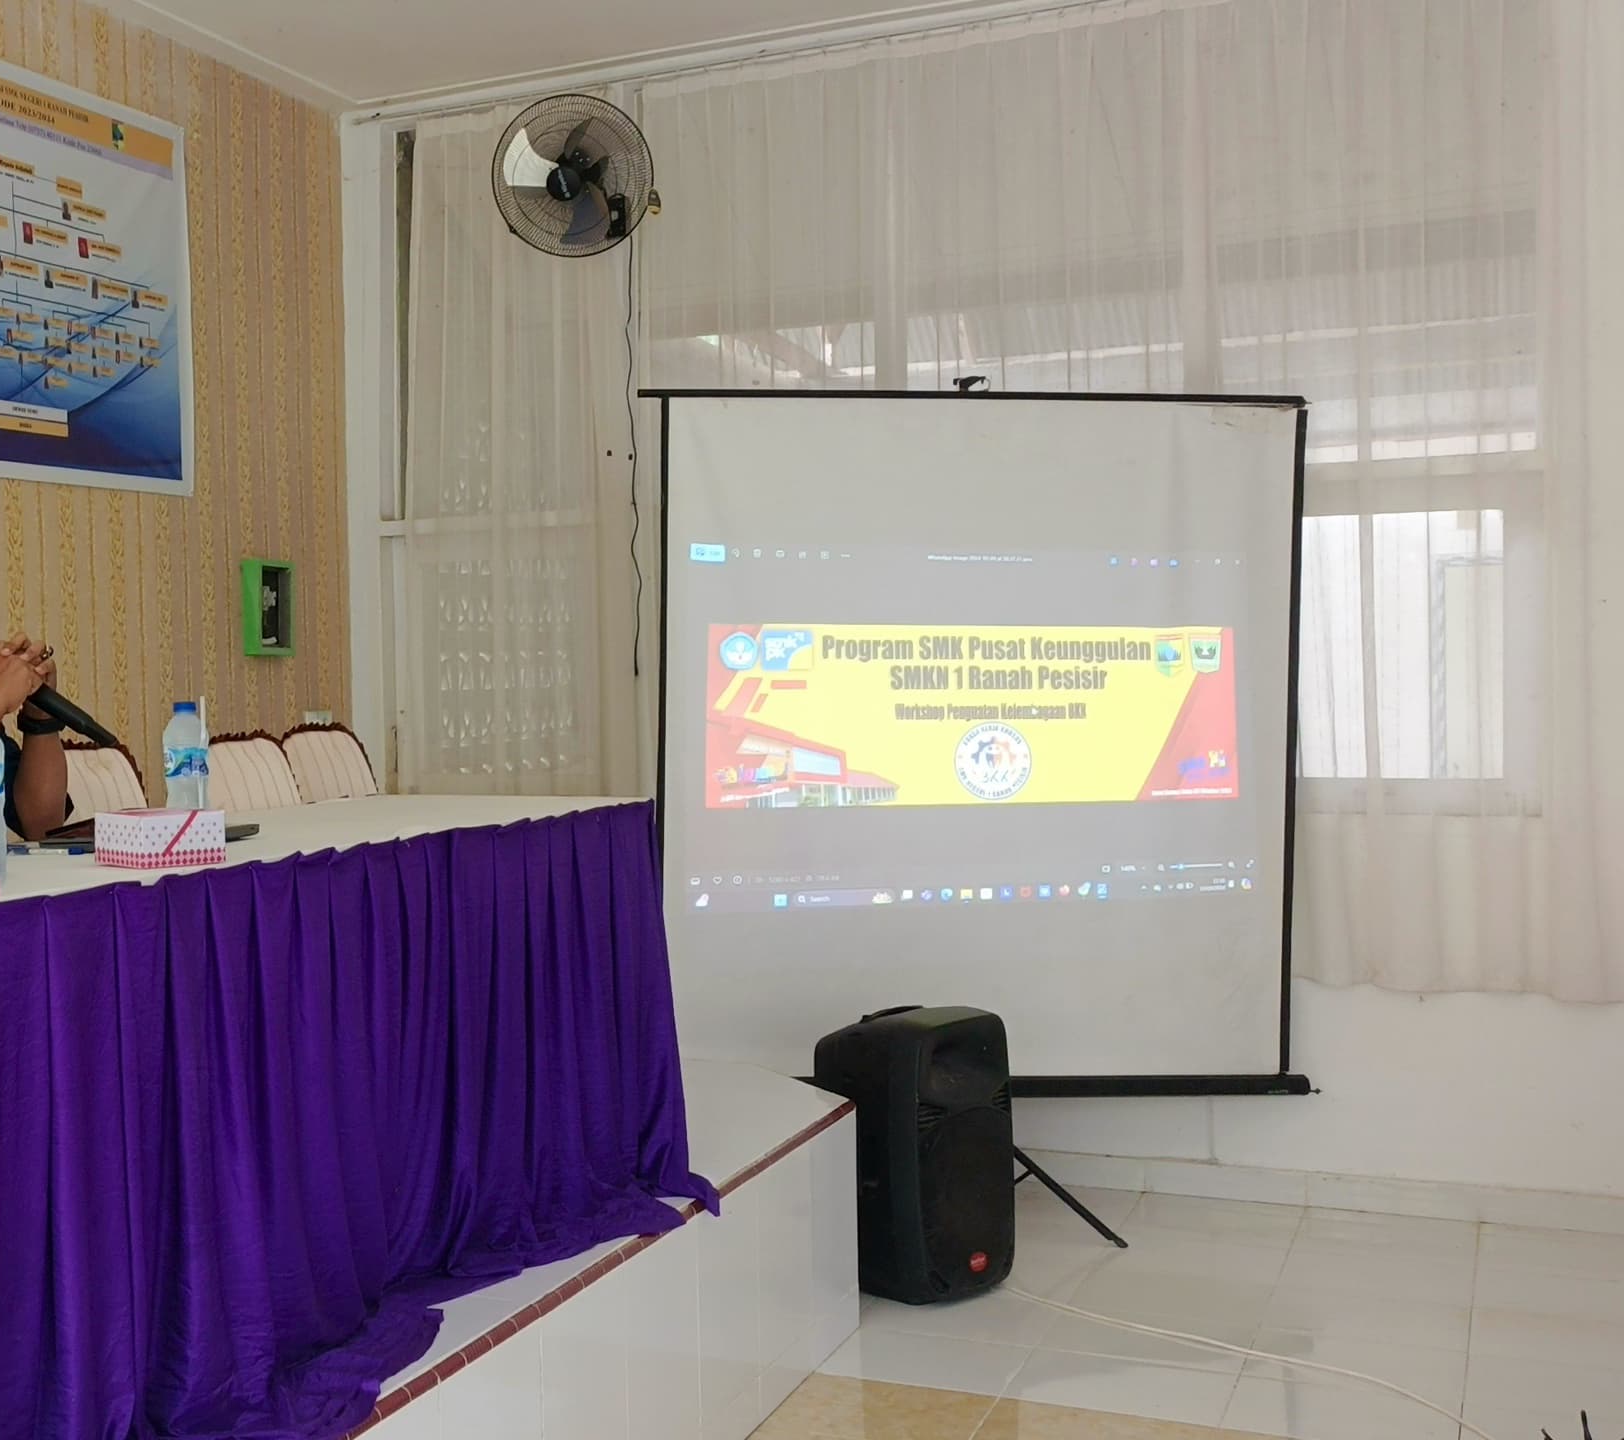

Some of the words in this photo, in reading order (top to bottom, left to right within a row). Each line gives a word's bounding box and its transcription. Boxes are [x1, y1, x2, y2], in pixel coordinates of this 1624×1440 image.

[822, 635, 913, 663] Program
[919, 636, 963, 660] SMK
[968, 637, 1026, 661] Pusat
[1030, 637, 1152, 663] Keunggulan
[890, 665, 949, 690] SMKN
[953, 665, 963, 690] 1
[968, 666, 1033, 690] Ranah
[1038, 666, 1108, 690] Pesisir
[895, 703, 945, 721] Workshop
[947, 703, 999, 721] Penguatan
